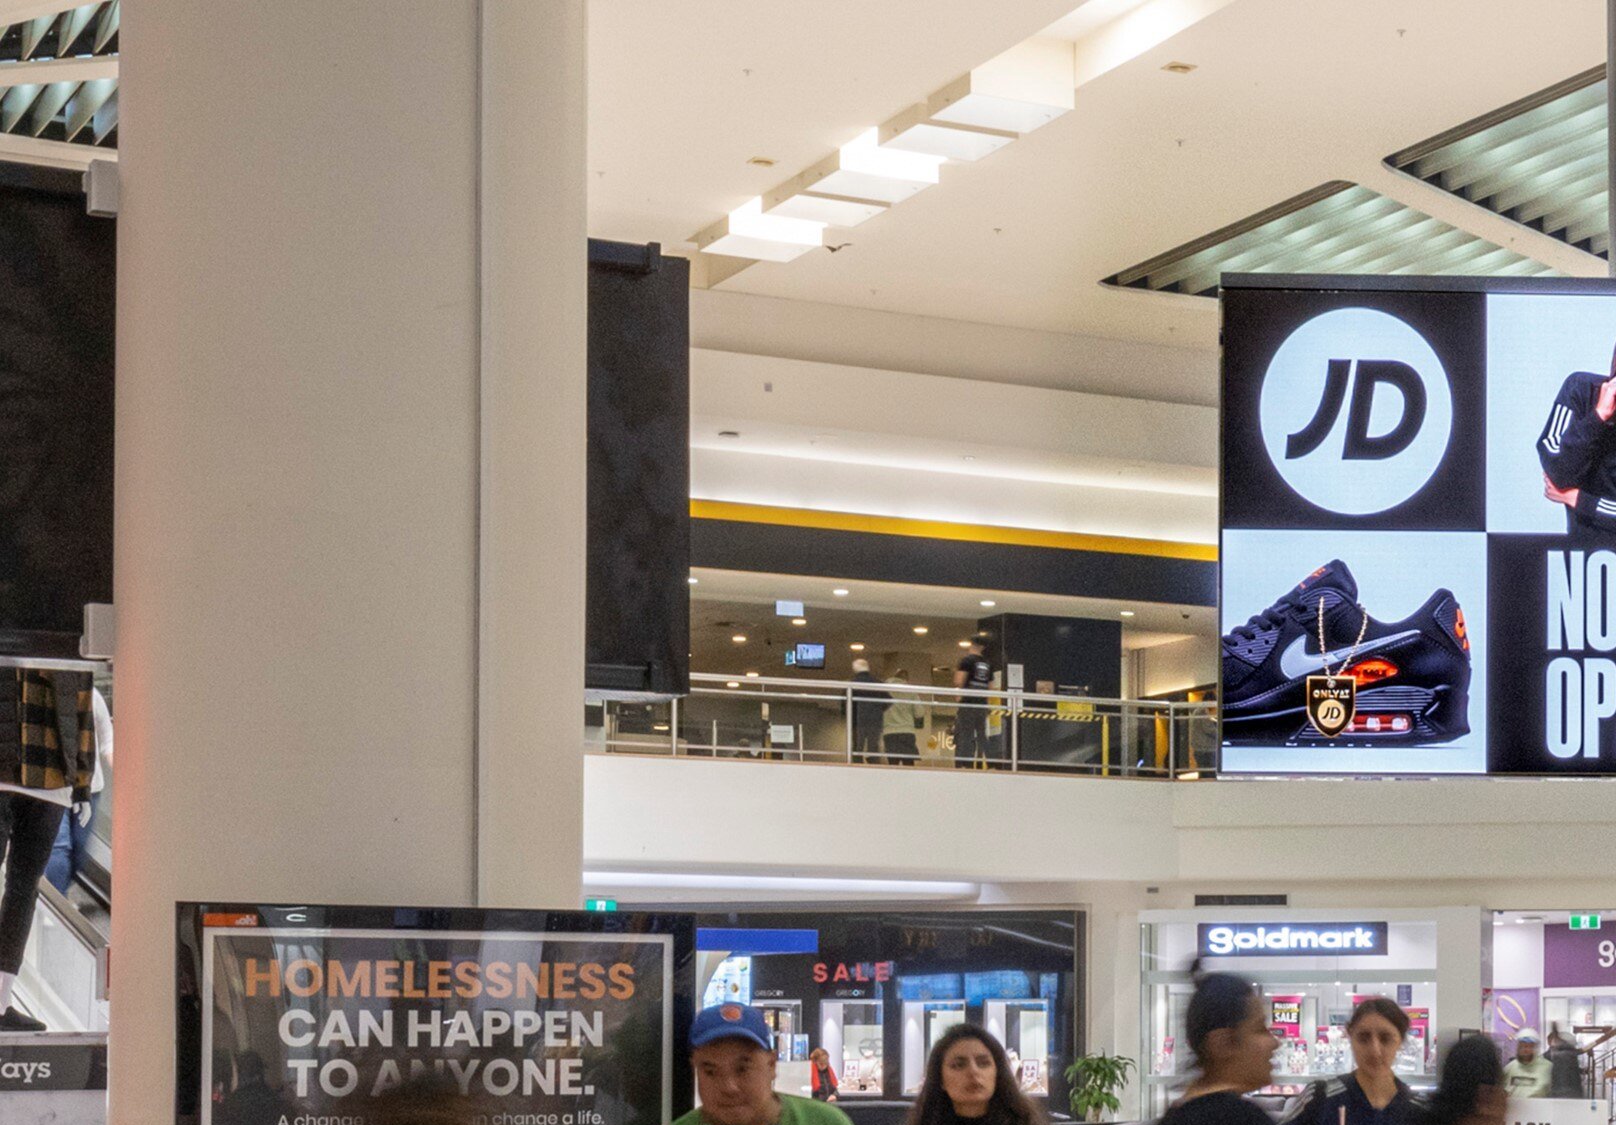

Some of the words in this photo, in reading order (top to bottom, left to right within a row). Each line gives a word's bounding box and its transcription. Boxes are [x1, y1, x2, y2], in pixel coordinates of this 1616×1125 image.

[1286, 359, 1427, 460] JD
[1321, 706, 1342, 721] JD
[1208, 926, 1375, 954] goldmark
[245, 958, 636, 1000] HOMELESSNESS
[813, 962, 890, 983] SALE
[278, 1009, 393, 1048] CAN
[407, 1010, 604, 1048] HAPPEN
[1274, 1012, 1298, 1023] SALE
[0, 1058, 51, 1083] ays
[287, 1059, 358, 1097] TO
[562, 1113, 573, 1125] a
[578, 1110, 605, 1125] life.
